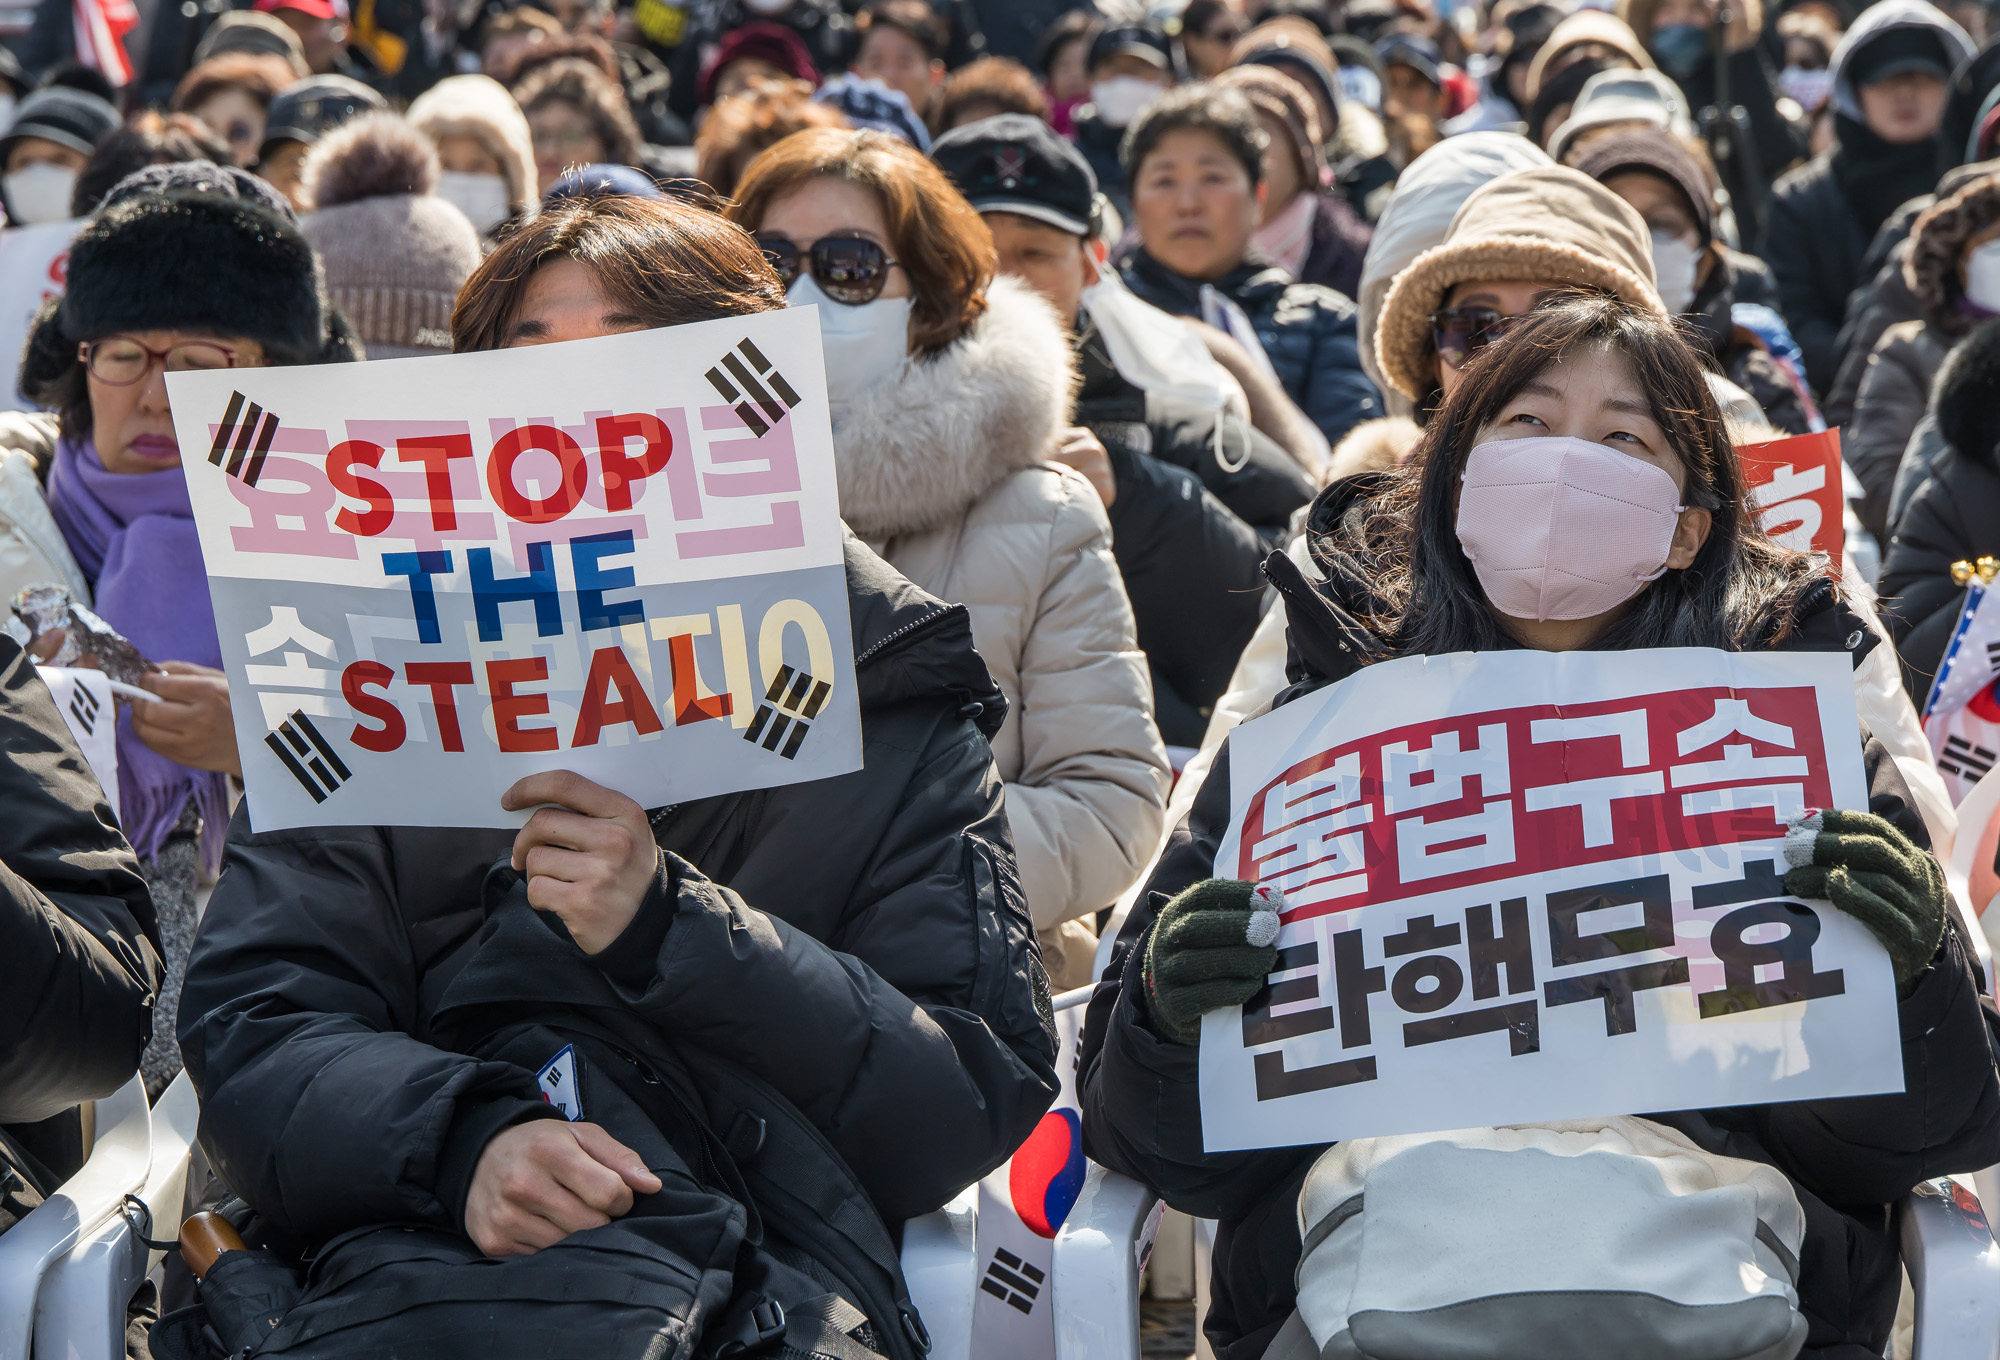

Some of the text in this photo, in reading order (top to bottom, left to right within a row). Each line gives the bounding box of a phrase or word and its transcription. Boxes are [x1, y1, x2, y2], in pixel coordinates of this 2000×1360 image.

[325, 412, 673, 536] STOP
[381, 529, 645, 643] THE
[341, 633, 733, 752] STEAL
[1252, 699, 1809, 902] 불법구속
[1242, 858, 1846, 1102] 탄핵무효
